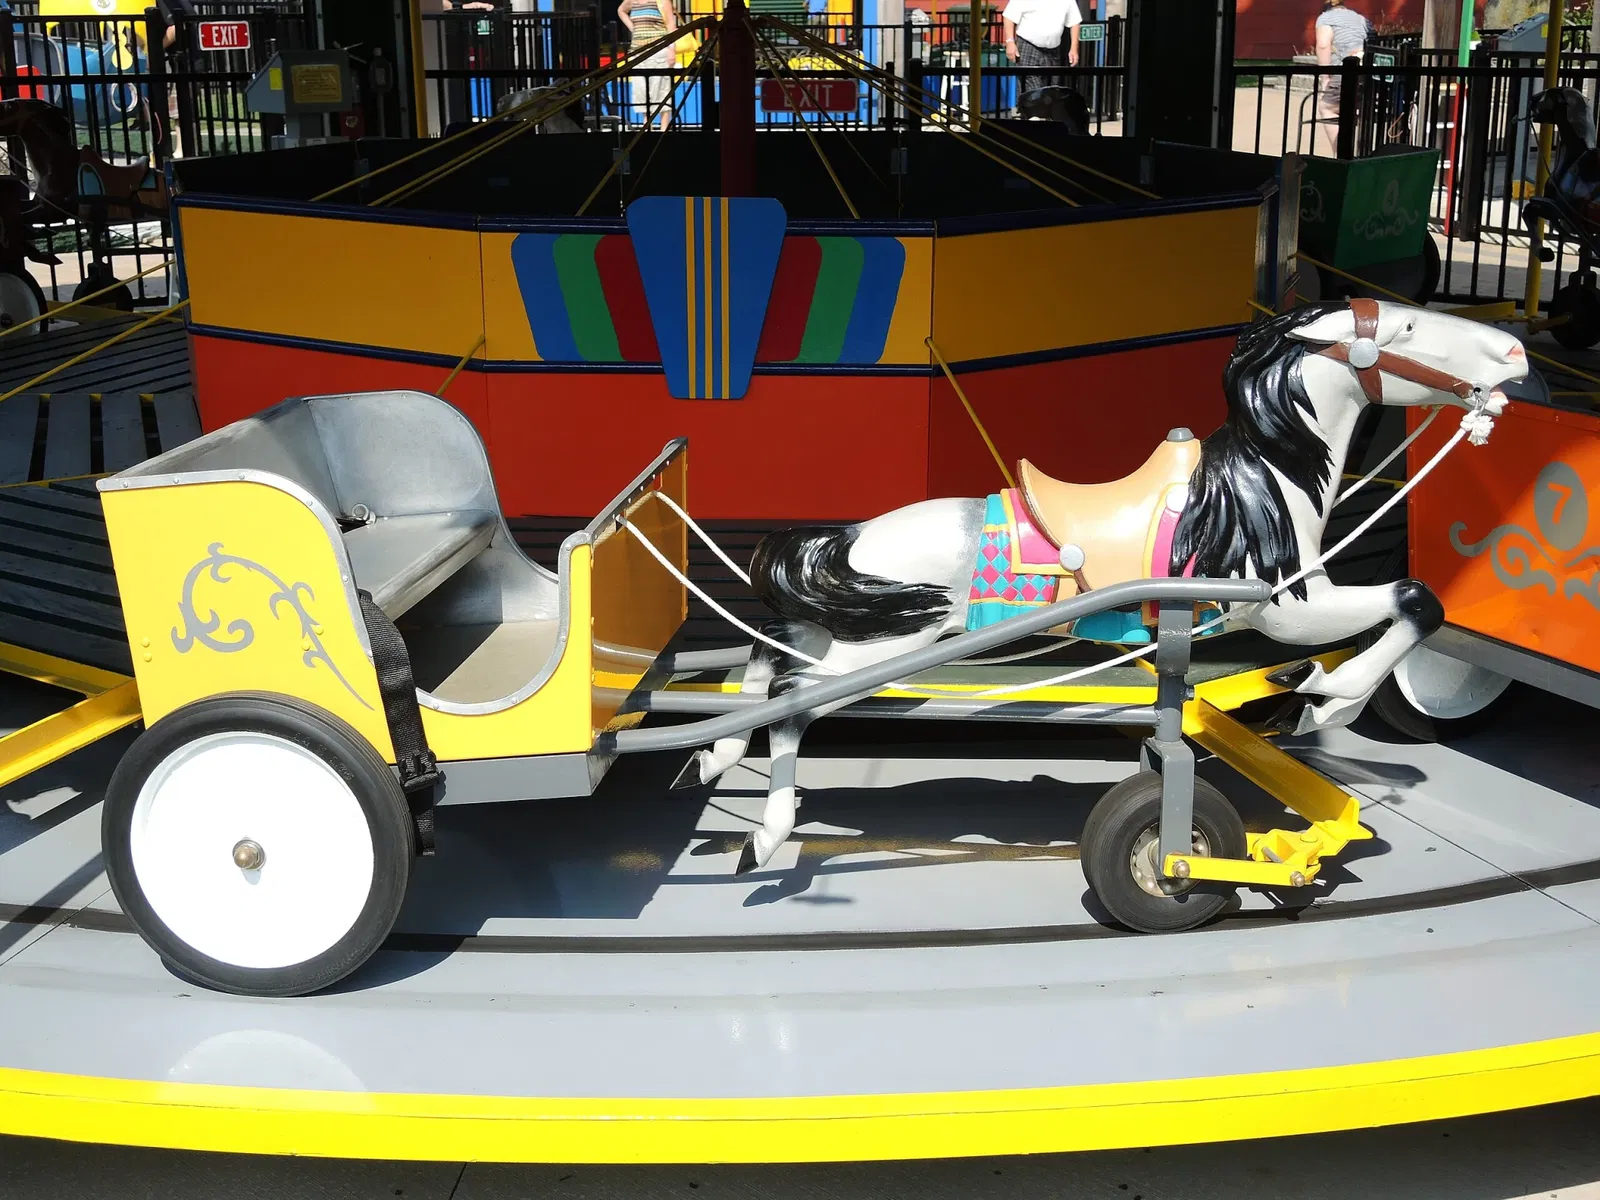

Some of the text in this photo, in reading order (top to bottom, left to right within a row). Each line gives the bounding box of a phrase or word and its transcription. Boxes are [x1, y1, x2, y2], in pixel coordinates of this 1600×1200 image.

[212, 26, 238, 46] EXIT
[1081, 27, 1102, 39] ENTER
[784, 84, 833, 107] EXIT
[1547, 481, 1573, 525] 7
